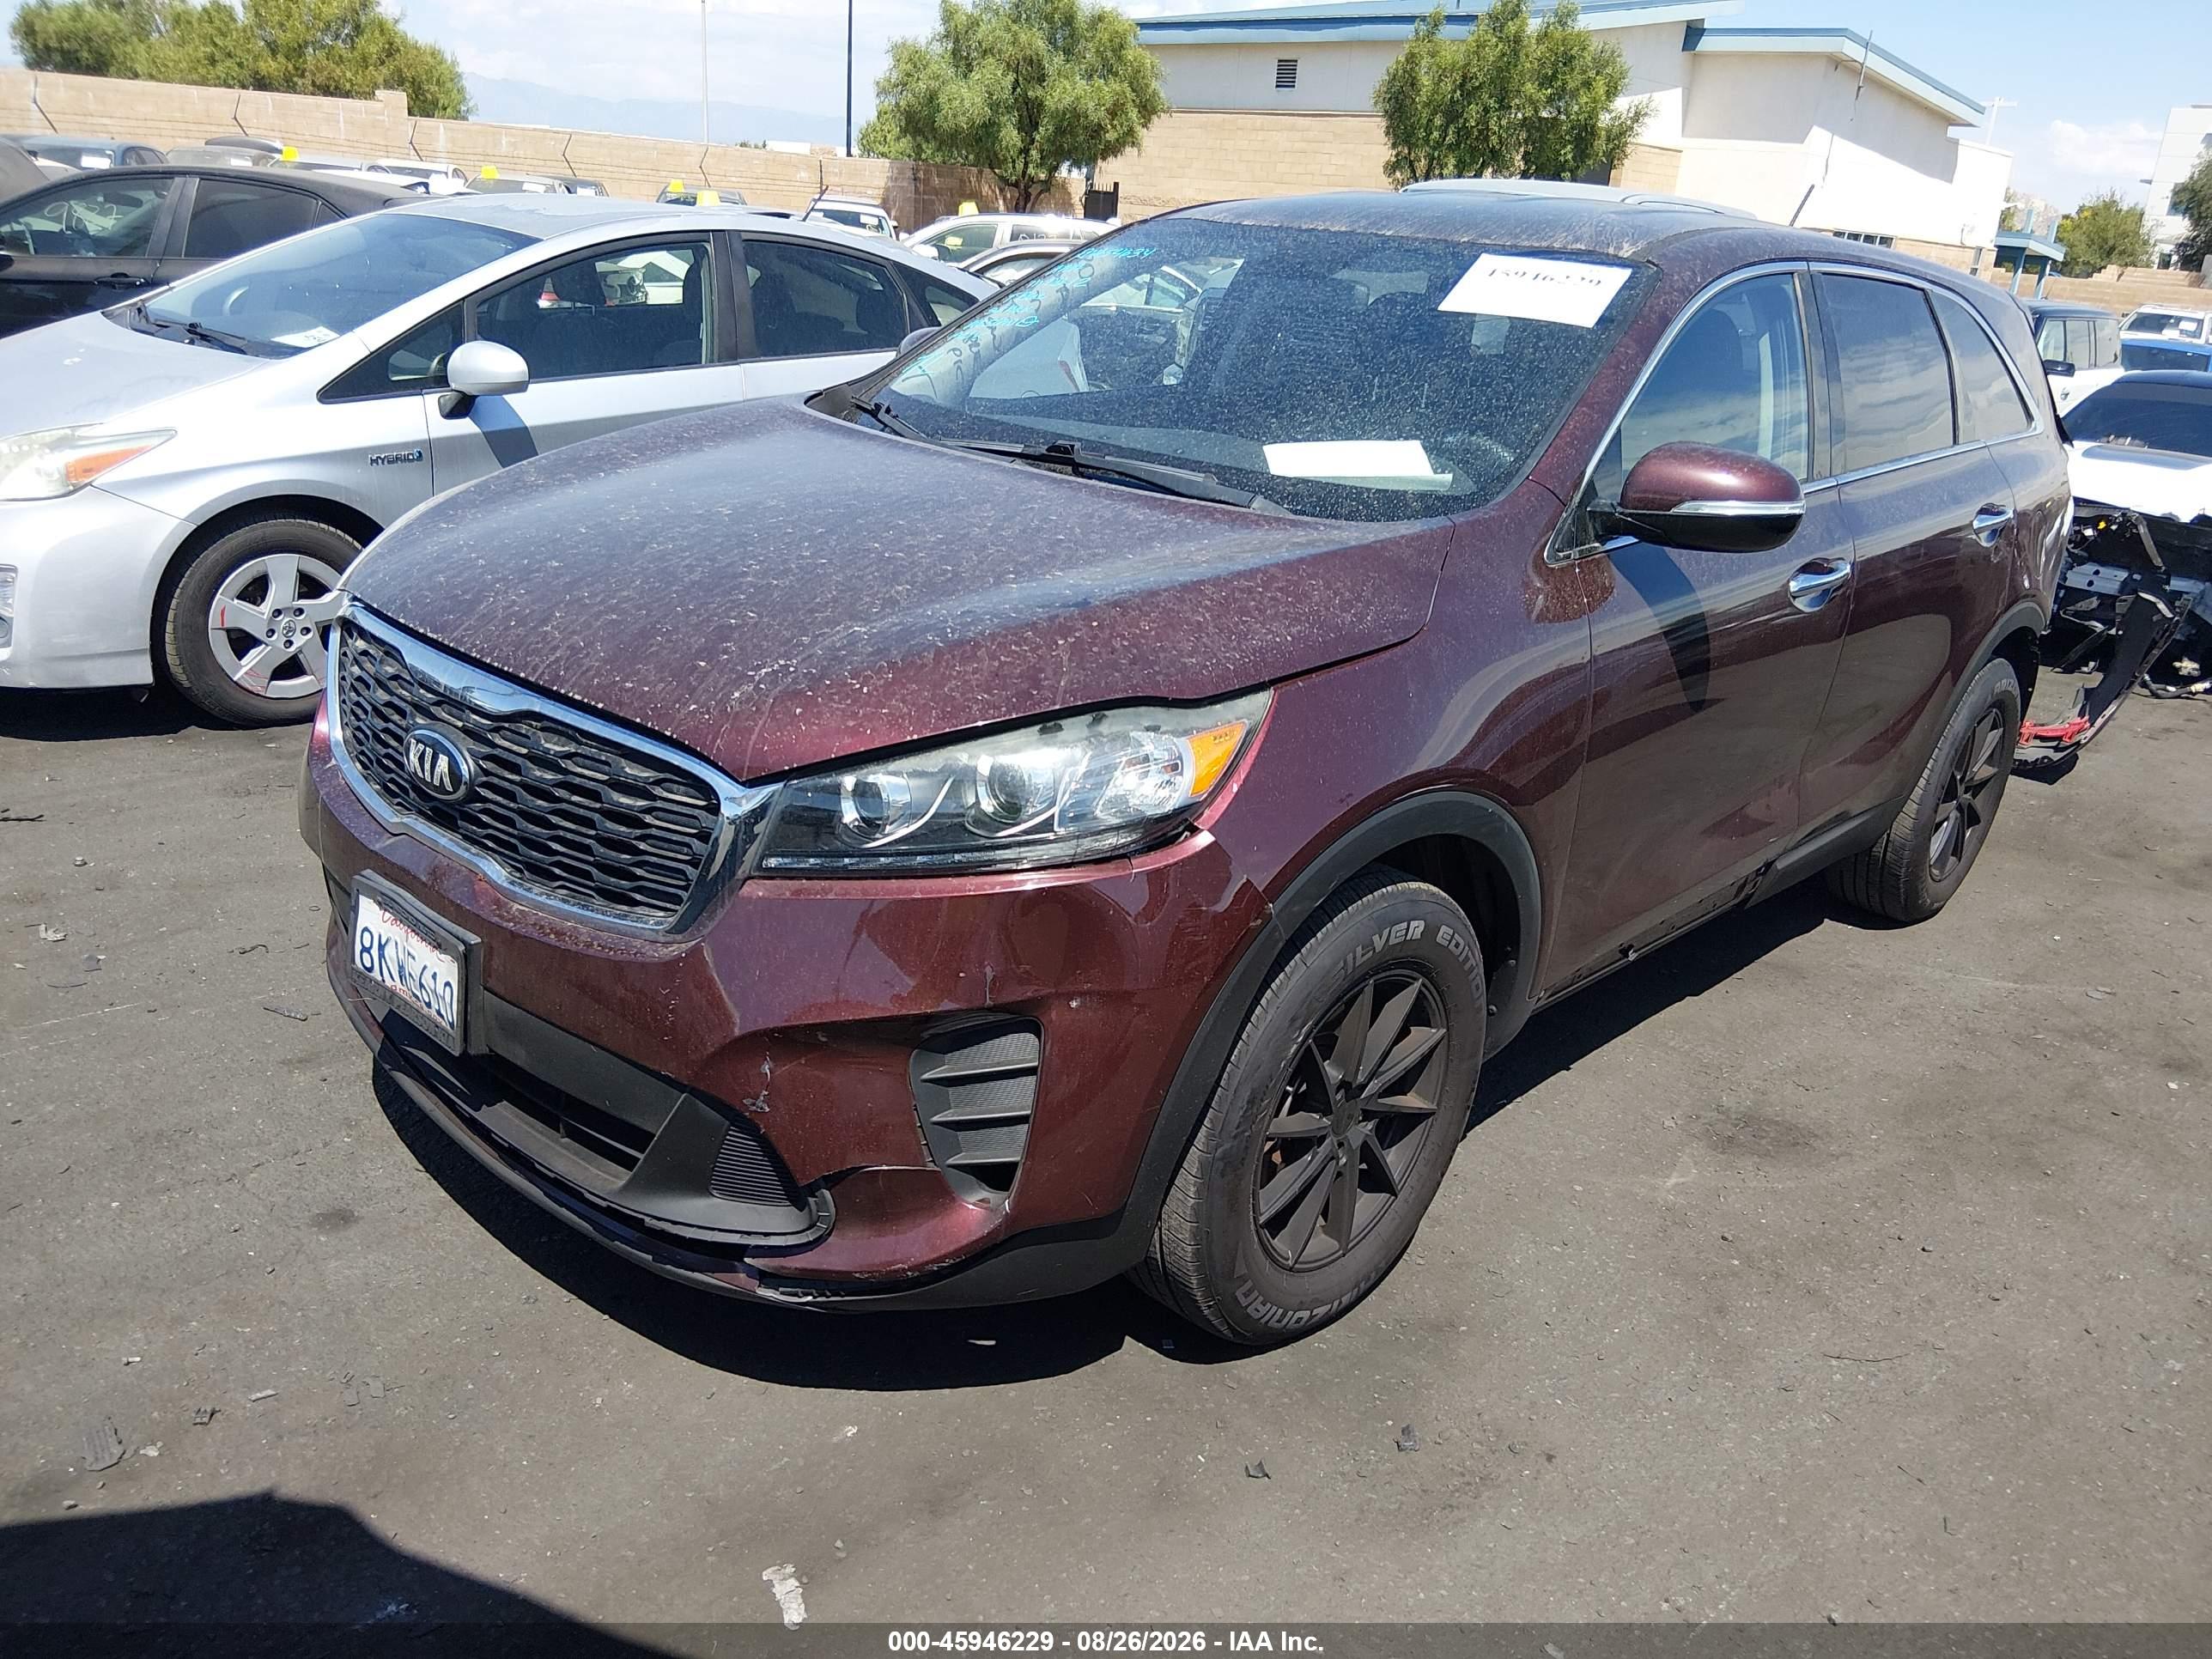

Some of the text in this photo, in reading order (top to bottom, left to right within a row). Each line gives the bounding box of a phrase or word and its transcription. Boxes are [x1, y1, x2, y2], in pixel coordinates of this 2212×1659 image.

[369, 452, 415, 466] HYBRID
[409, 738, 453, 792] KIA
[359, 925, 456, 1030] 8KWE610
[1328, 920, 1425, 992] SILVER
